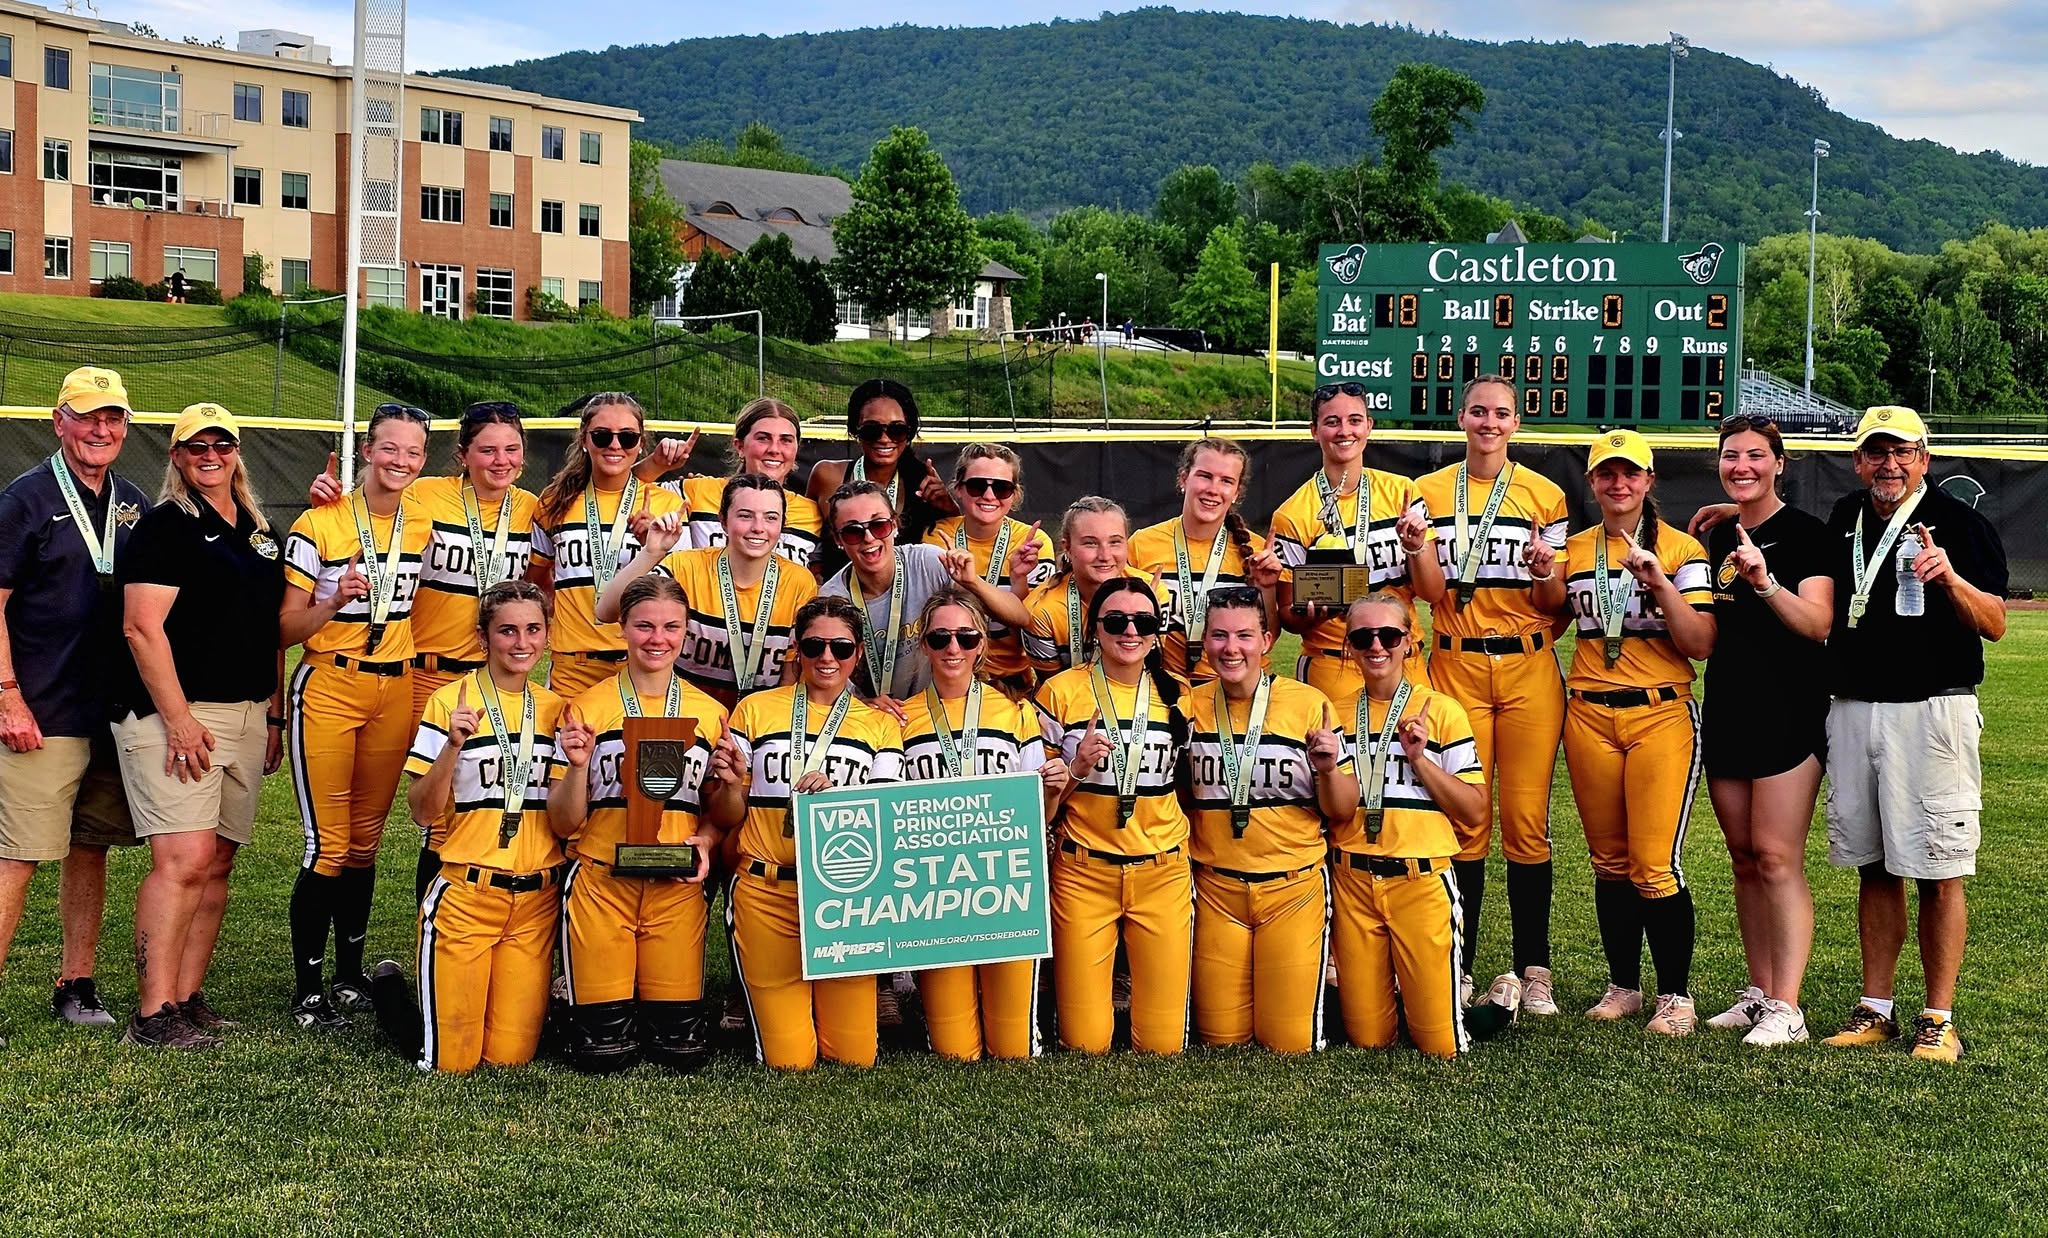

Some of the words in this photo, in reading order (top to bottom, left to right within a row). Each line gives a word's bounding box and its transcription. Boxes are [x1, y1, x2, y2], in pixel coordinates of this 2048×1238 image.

[1427, 247, 1617, 283] Castleton
[1338, 293, 1361, 312] At
[1389, 295, 1416, 325] 18
[1443, 300, 1490, 320] Ball
[1495, 295, 1512, 325] 0
[1529, 299, 1599, 320] Strike
[1603, 295, 1622, 327] 0
[1655, 300, 1703, 321] Out
[1709, 295, 1727, 327] 2
[1332, 313, 1366, 332] Bat
[1416, 335, 1424, 351] 1
[1441, 335, 1452, 352] 2
[1467, 336, 1477, 352] 3
[1502, 336, 1514, 352] 4
[1530, 336, 1540, 352] 5
[1555, 336, 1566, 353] 6
[1593, 336, 1604, 353] 7
[1620, 336, 1631, 354] 8
[1647, 337, 1658, 354] 9
[1682, 337, 1727, 354] Runs
[1318, 353, 1392, 377] Guest
[1414, 354, 1427, 379] 0
[1439, 355, 1452, 379] 0
[1501, 356, 1515, 380] 0
[1526, 356, 1540, 380] 0
[1553, 356, 1567, 380] 0
[1526, 389, 1540, 413] 0
[1552, 389, 1566, 413] 0
[1707, 392, 1721, 417] 2
[588, 501, 596, 517] 2026
[621, 489, 633, 515] Softball
[1475, 521, 1489, 549] Softball
[1485, 503, 1496, 520] 2025
[1494, 481, 1505, 497] 2026
[72, 500, 89, 532] Association
[471, 517, 479, 534] 2026
[1358, 514, 1366, 543] Softball
[362, 529, 371, 548] 2026
[1214, 529, 1227, 556] Softball
[368, 555, 376, 573] 2025
[593, 541, 603, 570] Softball
[988, 556, 1001, 584] Softball
[996, 537, 1006, 554] 2025
[724, 582, 733, 602] 2025
[894, 568, 902, 598] Softball
[757, 601, 770, 632] Softball
[764, 580, 773, 599] 2025
[1071, 603, 1079, 621] 2025
[1184, 595, 1193, 624] Softball
[1601, 595, 1611, 625] Softball
[727, 604, 738, 635] Softball
[627, 697, 637, 715] 2026
[668, 688, 677, 717] Softball
[491, 707, 502, 726] 2026
[825, 712, 841, 736] Softball
[839, 697, 847, 712] 2025
[1379, 723, 1393, 752] Softball
[1390, 704, 1400, 721] 2025
[1398, 682, 1409, 699] 2026
[499, 734, 509, 753] 2025
[794, 732, 802, 760] Softball
[942, 735, 952, 751] 2026
[1110, 727, 1120, 745] 2026
[1223, 738, 1232, 756] 2026
[505, 756, 513, 789] Softball
[949, 758, 962, 777] 2025
[1116, 754, 1124, 774] 2025
[1228, 763, 1238, 782] 2025
[891, 793, 992, 815] VERMONT
[818, 807, 873, 832] VPA
[893, 808, 1015, 833] PRINCIPALS'
[894, 826, 1028, 850] ASSOCIATION
[893, 848, 1031, 889] STATE
[815, 882, 1032, 930] CHAMPION
[813, 940, 886, 963] MAXPREPS
[896, 929, 1039, 949] VPAONLINE.ORG/VTSCOREBOARD
